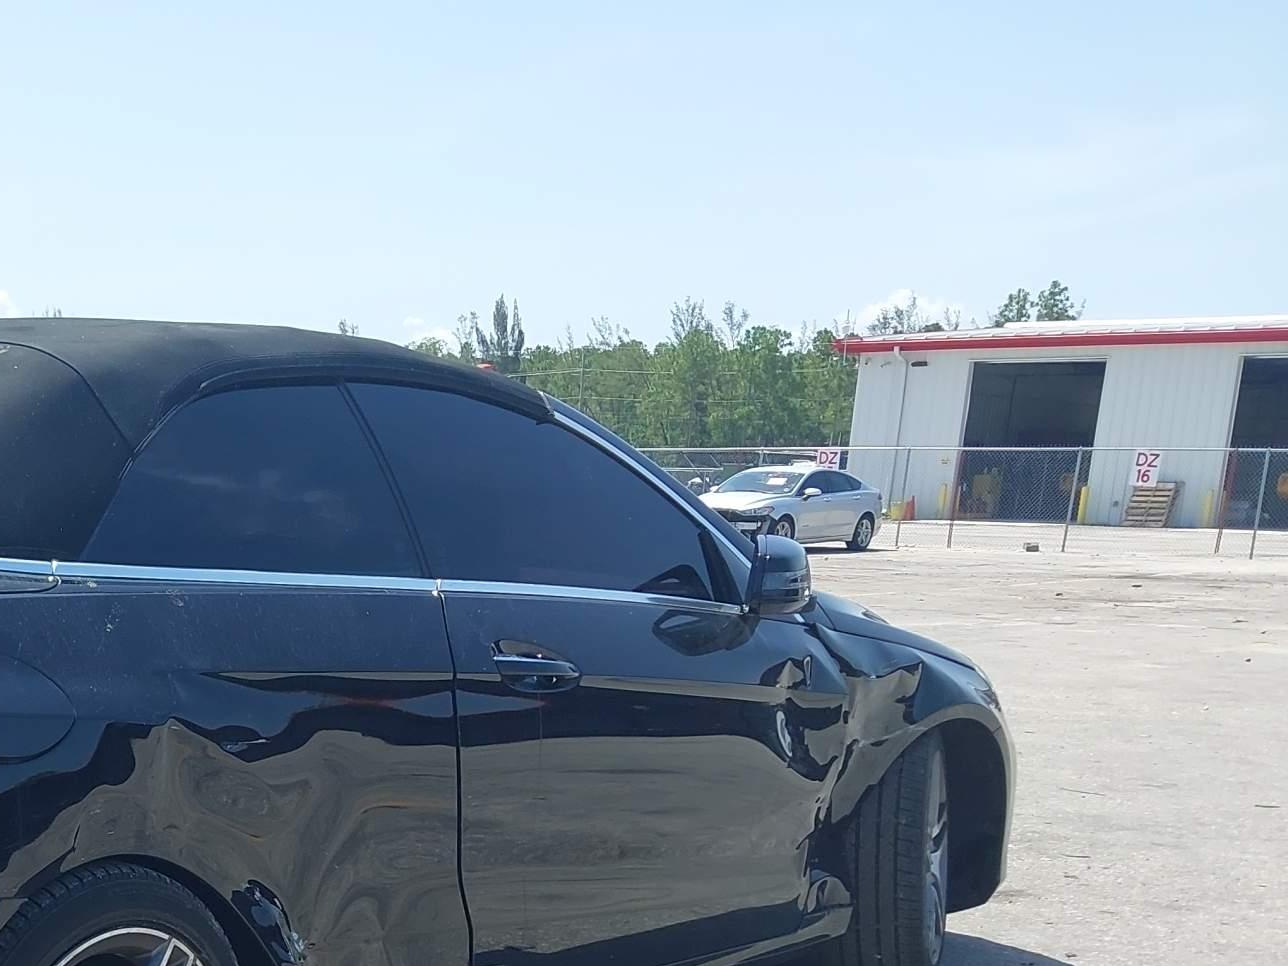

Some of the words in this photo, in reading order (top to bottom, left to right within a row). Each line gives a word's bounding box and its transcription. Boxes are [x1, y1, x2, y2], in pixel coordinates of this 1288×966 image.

[819, 451, 839, 465] DZ
[1135, 452, 1161, 468] DZ
[1135, 468, 1151, 483] 16
